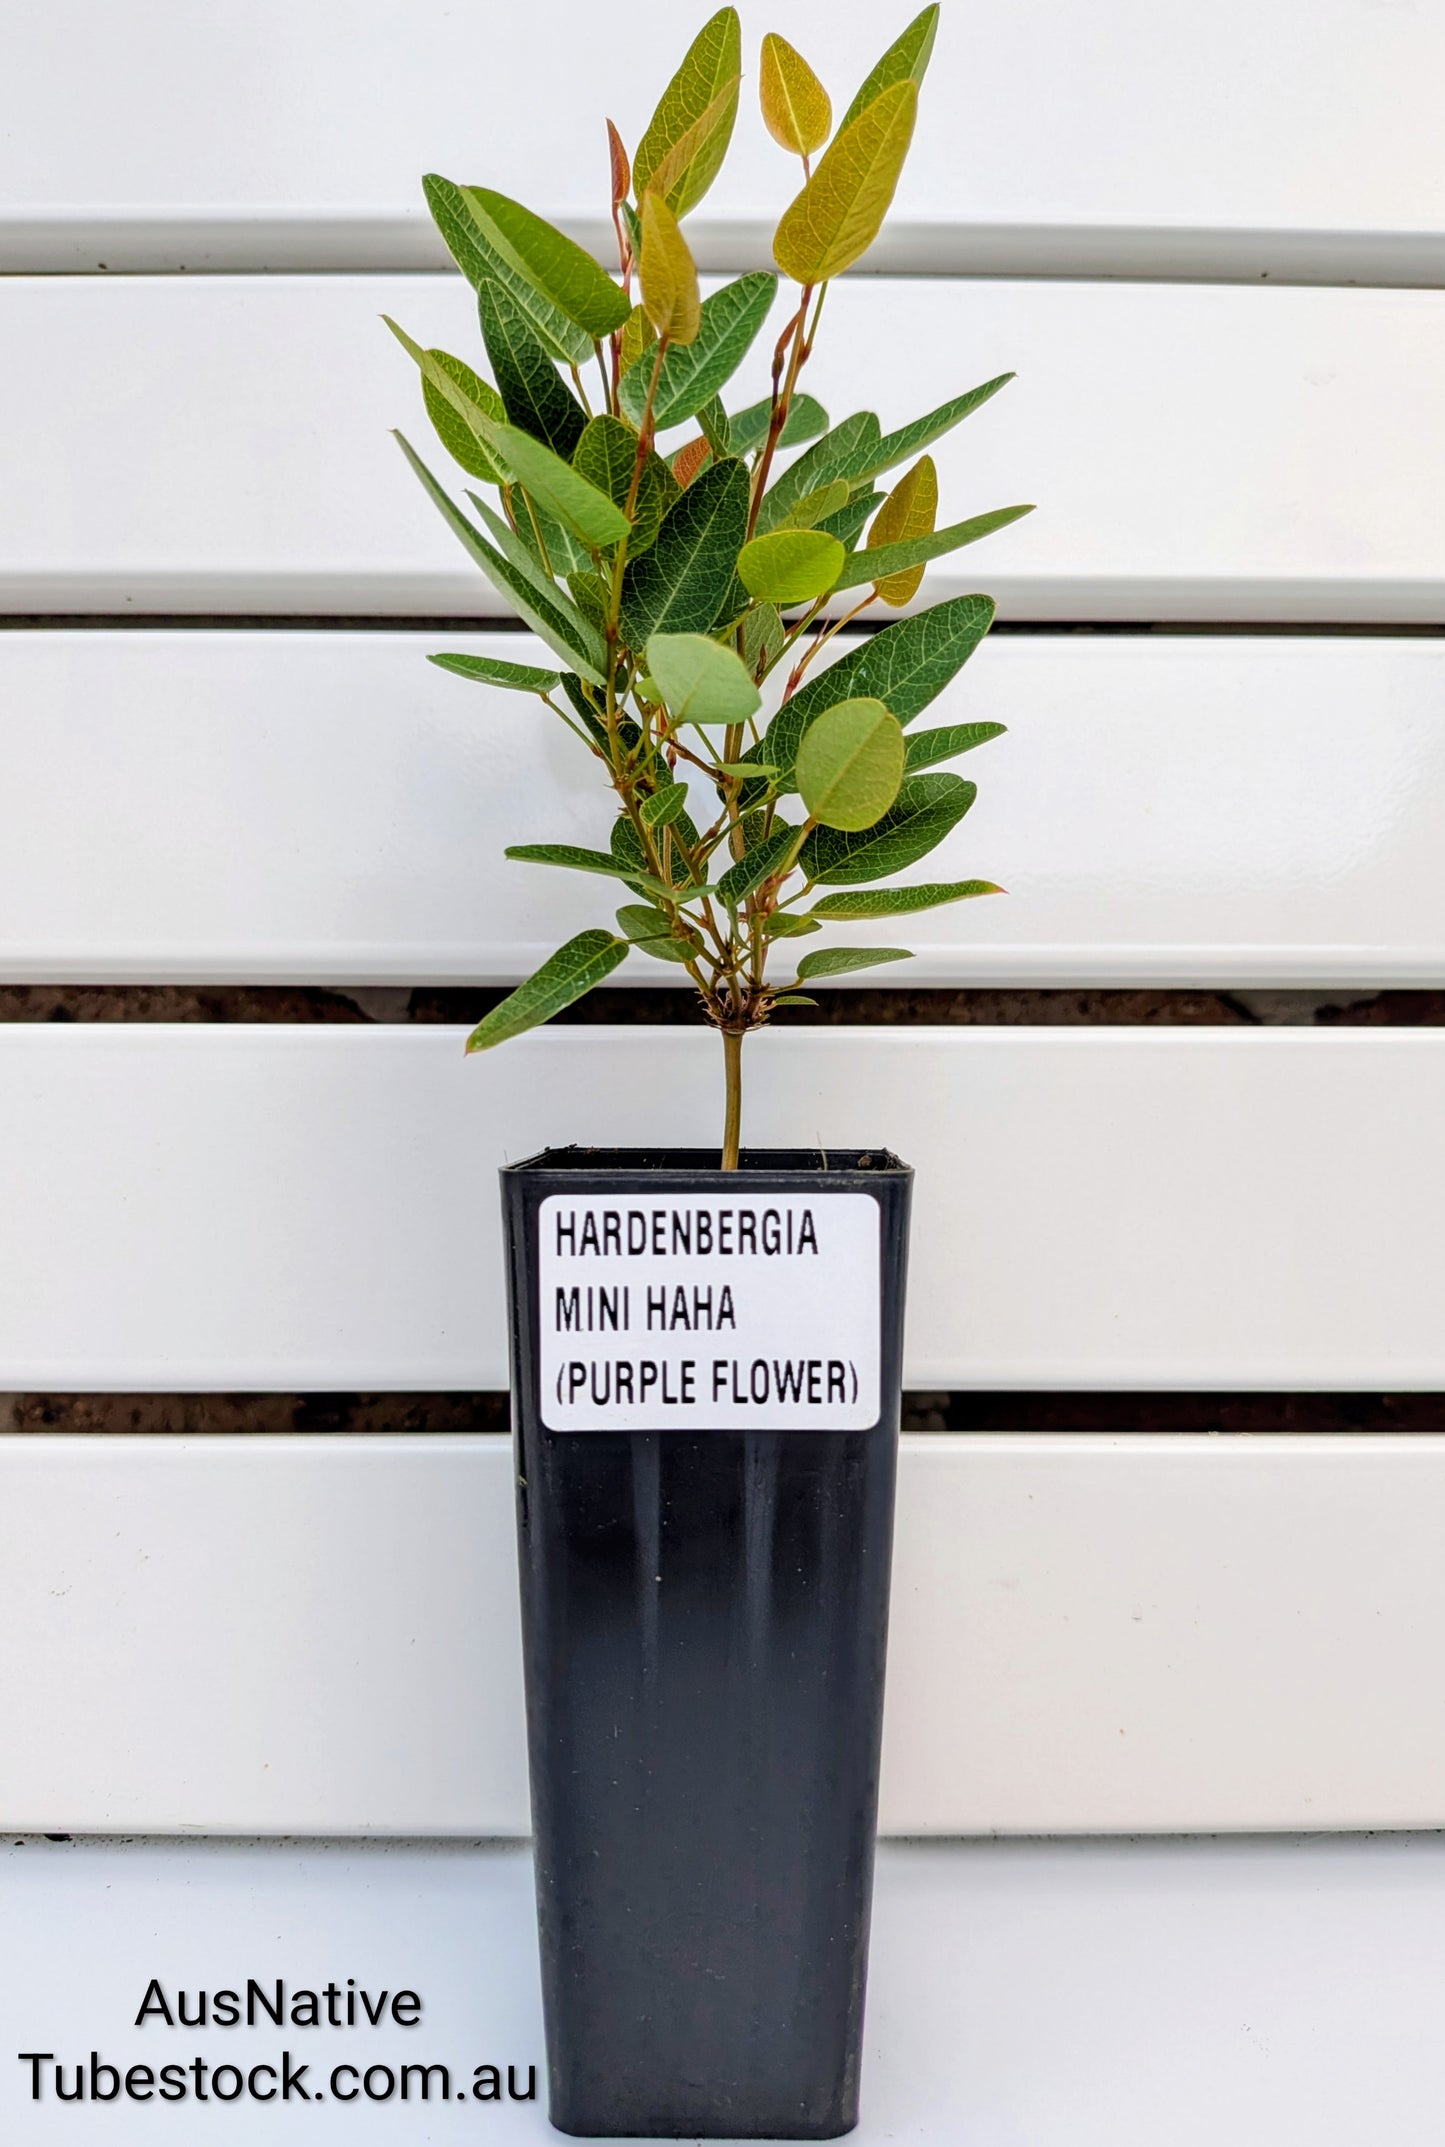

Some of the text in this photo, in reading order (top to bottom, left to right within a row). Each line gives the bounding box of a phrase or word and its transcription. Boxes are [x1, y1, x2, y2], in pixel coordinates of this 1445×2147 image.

[556, 1208, 819, 1257] HARDENBERGIA
[556, 1285, 736, 1332] MINI HAHA
[555, 1358, 860, 1407] (PURPLE FLOWER)
